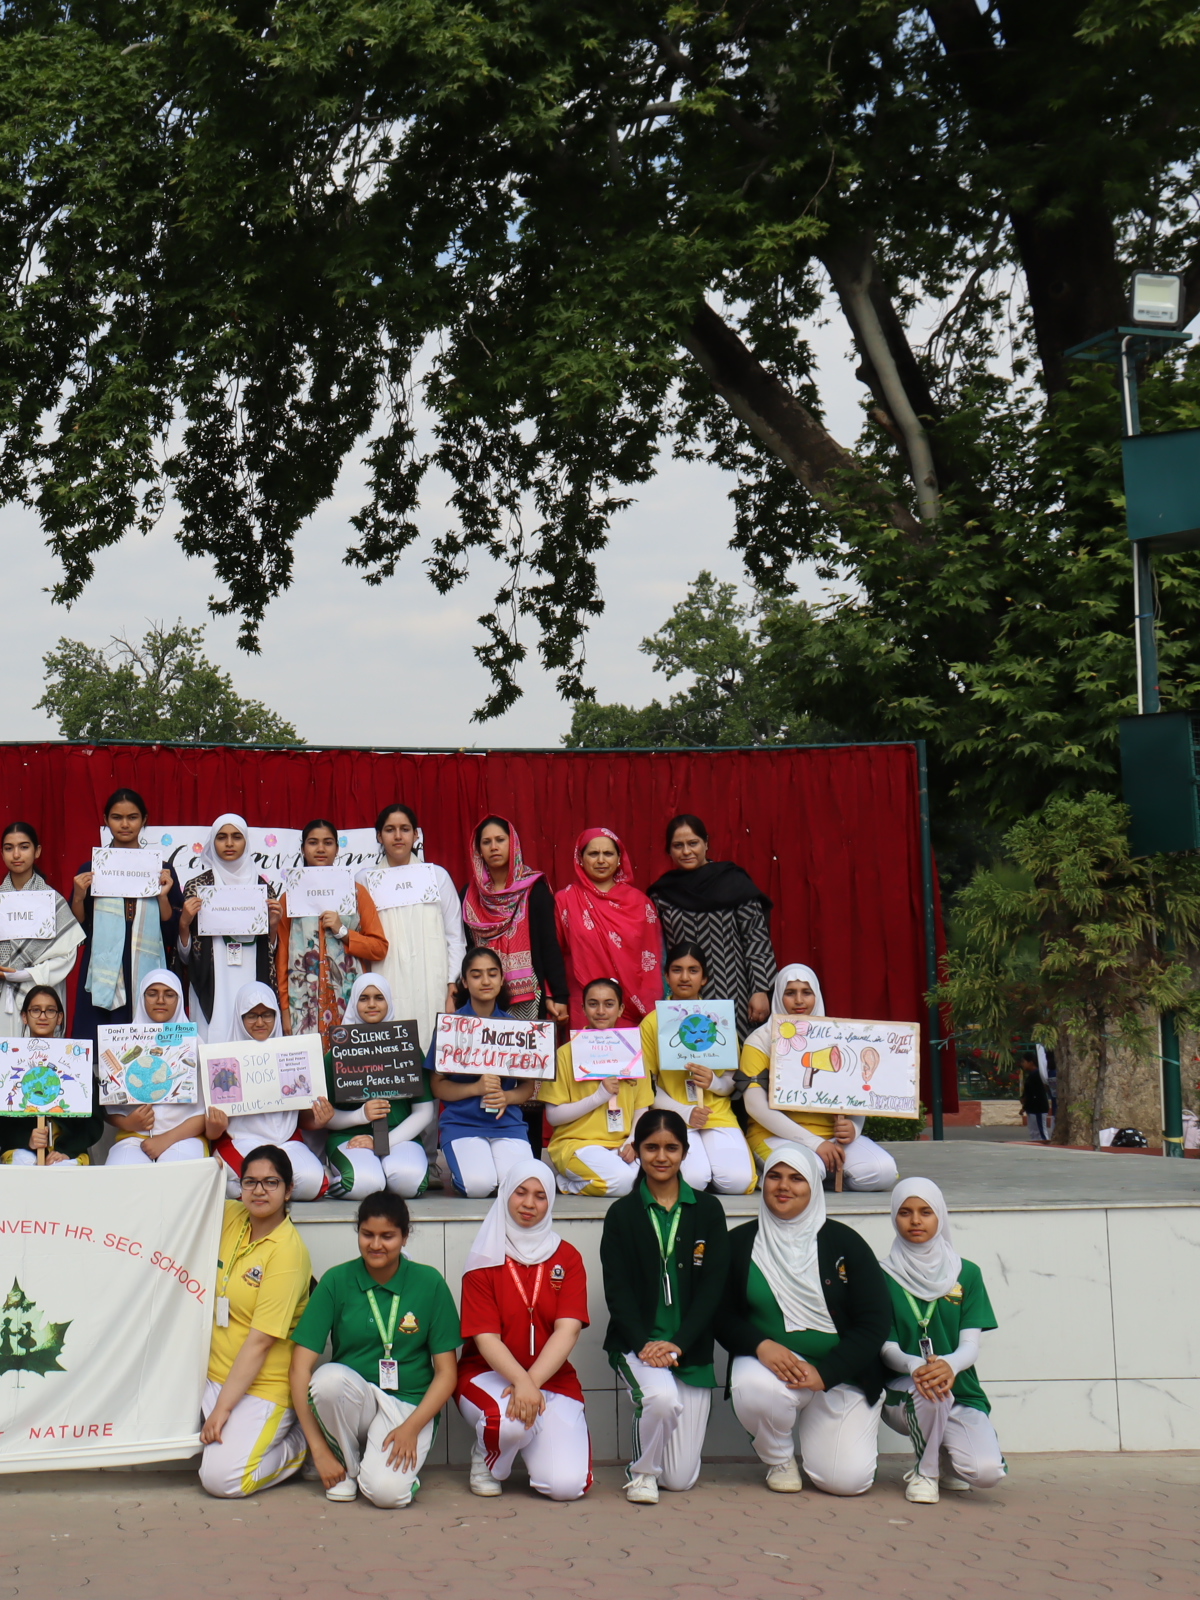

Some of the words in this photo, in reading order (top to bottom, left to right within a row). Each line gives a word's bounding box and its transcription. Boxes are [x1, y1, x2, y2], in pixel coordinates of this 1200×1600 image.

[307, 889, 335, 897] FOREST
[395, 882, 413, 891] AIR
[6, 911, 34, 922] TIME
[143, 1026, 163, 1034] LOUD
[174, 1025, 196, 1034] PROUD
[442, 1016, 483, 1035] STOP
[806, 1025, 832, 1040] PEACE
[834, 1032, 843, 1040] is
[157, 1033, 174, 1043] OUT
[350, 1028, 391, 1045] SILENCE
[392, 1024, 409, 1040] IS
[481, 1028, 538, 1050] NOISE
[374, 1044, 399, 1055] NOISE
[400, 1041, 415, 1052] IS
[243, 1052, 271, 1067] STOP
[439, 1044, 551, 1070] POLLUTION
[335, 1061, 385, 1075] POLLUTION
[393, 1058, 415, 1070] LET'S
[336, 1077, 364, 1089] CHOOSE
[393, 1075, 406, 1084] BE
[406, 1073, 420, 1083] THE
[363, 1087, 400, 1100] SOLUTION
[777, 1089, 808, 1105] LET'S
[811, 1091, 843, 1107] Keep
[64, 1223, 96, 1244] HR.
[102, 1232, 144, 1259] SEC.
[149, 1249, 208, 1305] SCHOOL
[28, 1422, 114, 1440] NATURE
